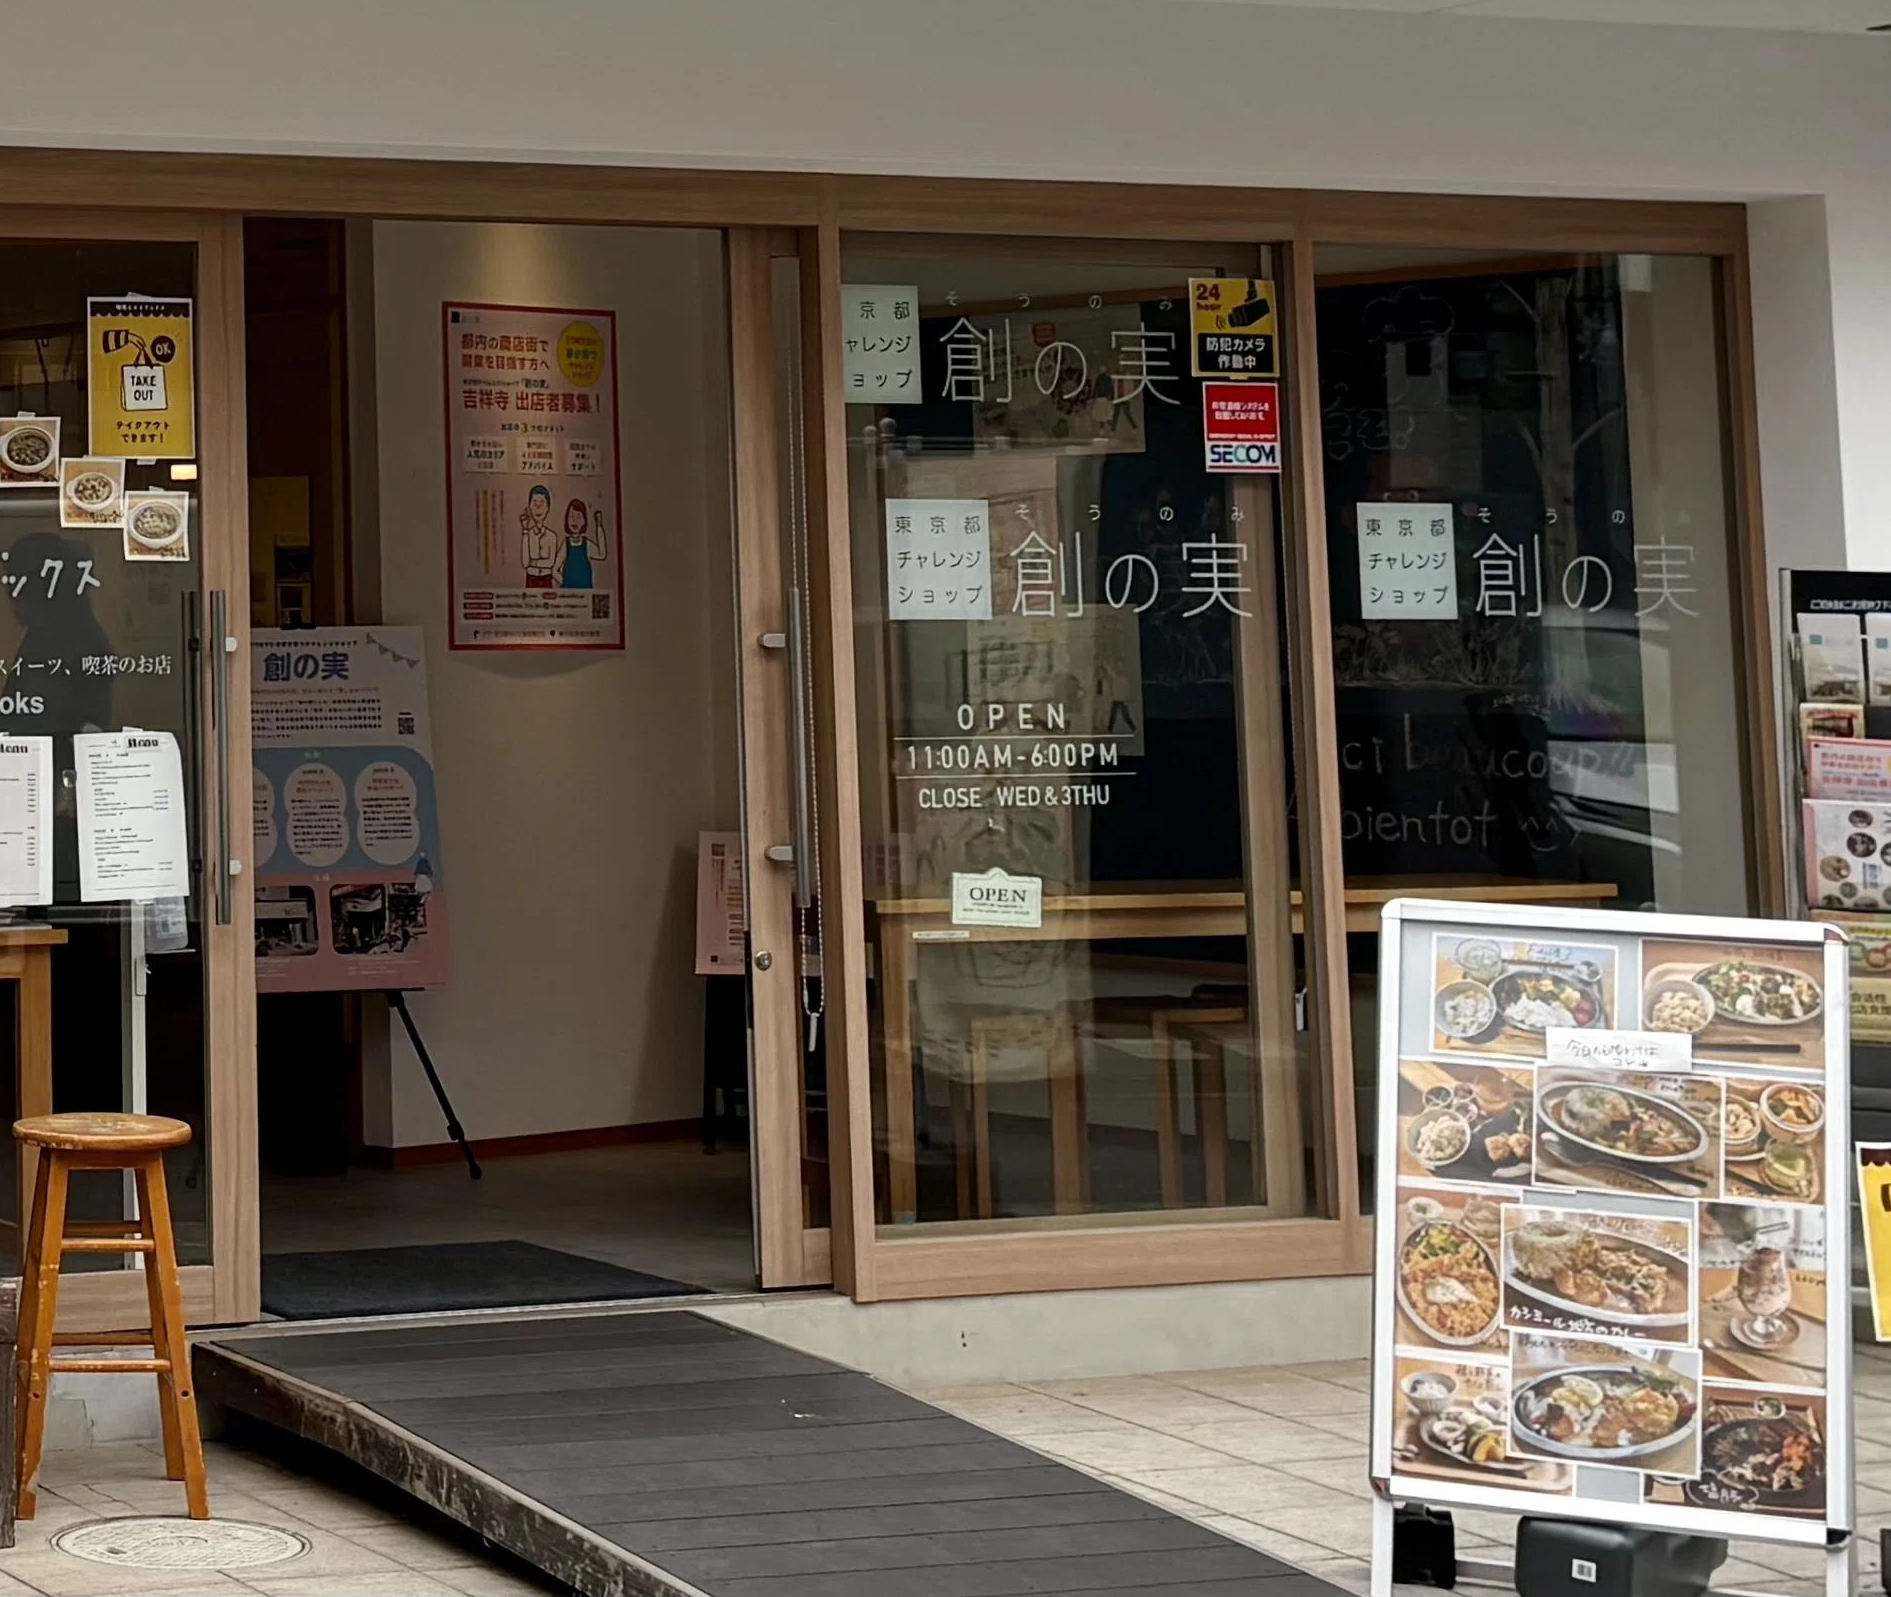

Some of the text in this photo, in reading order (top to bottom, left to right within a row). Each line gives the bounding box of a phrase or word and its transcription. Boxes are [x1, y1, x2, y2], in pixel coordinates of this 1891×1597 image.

[1196, 283, 1221, 301] 24
[155, 342, 172, 356] OK
[1206, 337, 1266, 353] 防犯カメラ
[938, 316, 1181, 405] 創の実
[1218, 354, 1256, 370] 作動中
[130, 375, 157, 387] TAKE
[134, 389, 154, 402] OUT
[462, 389, 509, 411] 吉祥寺
[116, 420, 169, 430] テイクアウト
[1210, 444, 1276, 464] SECOM
[895, 515, 981, 535] 東京都
[1365, 518, 1445, 537] 東京都
[896, 549, 982, 569] チャレンジ
[1368, 552, 1447, 571] チャレンジ
[1010, 530, 1253, 618] 創の実
[1472, 533, 1701, 617] 創の実
[897, 585, 983, 605] ショップ
[1370, 585, 1449, 604] ショップ
[263, 651, 349, 682] 創の実
[957, 703, 1066, 731] OPEN
[918, 787, 981, 809] CLOSE
[969, 887, 1027, 903] OPEN
